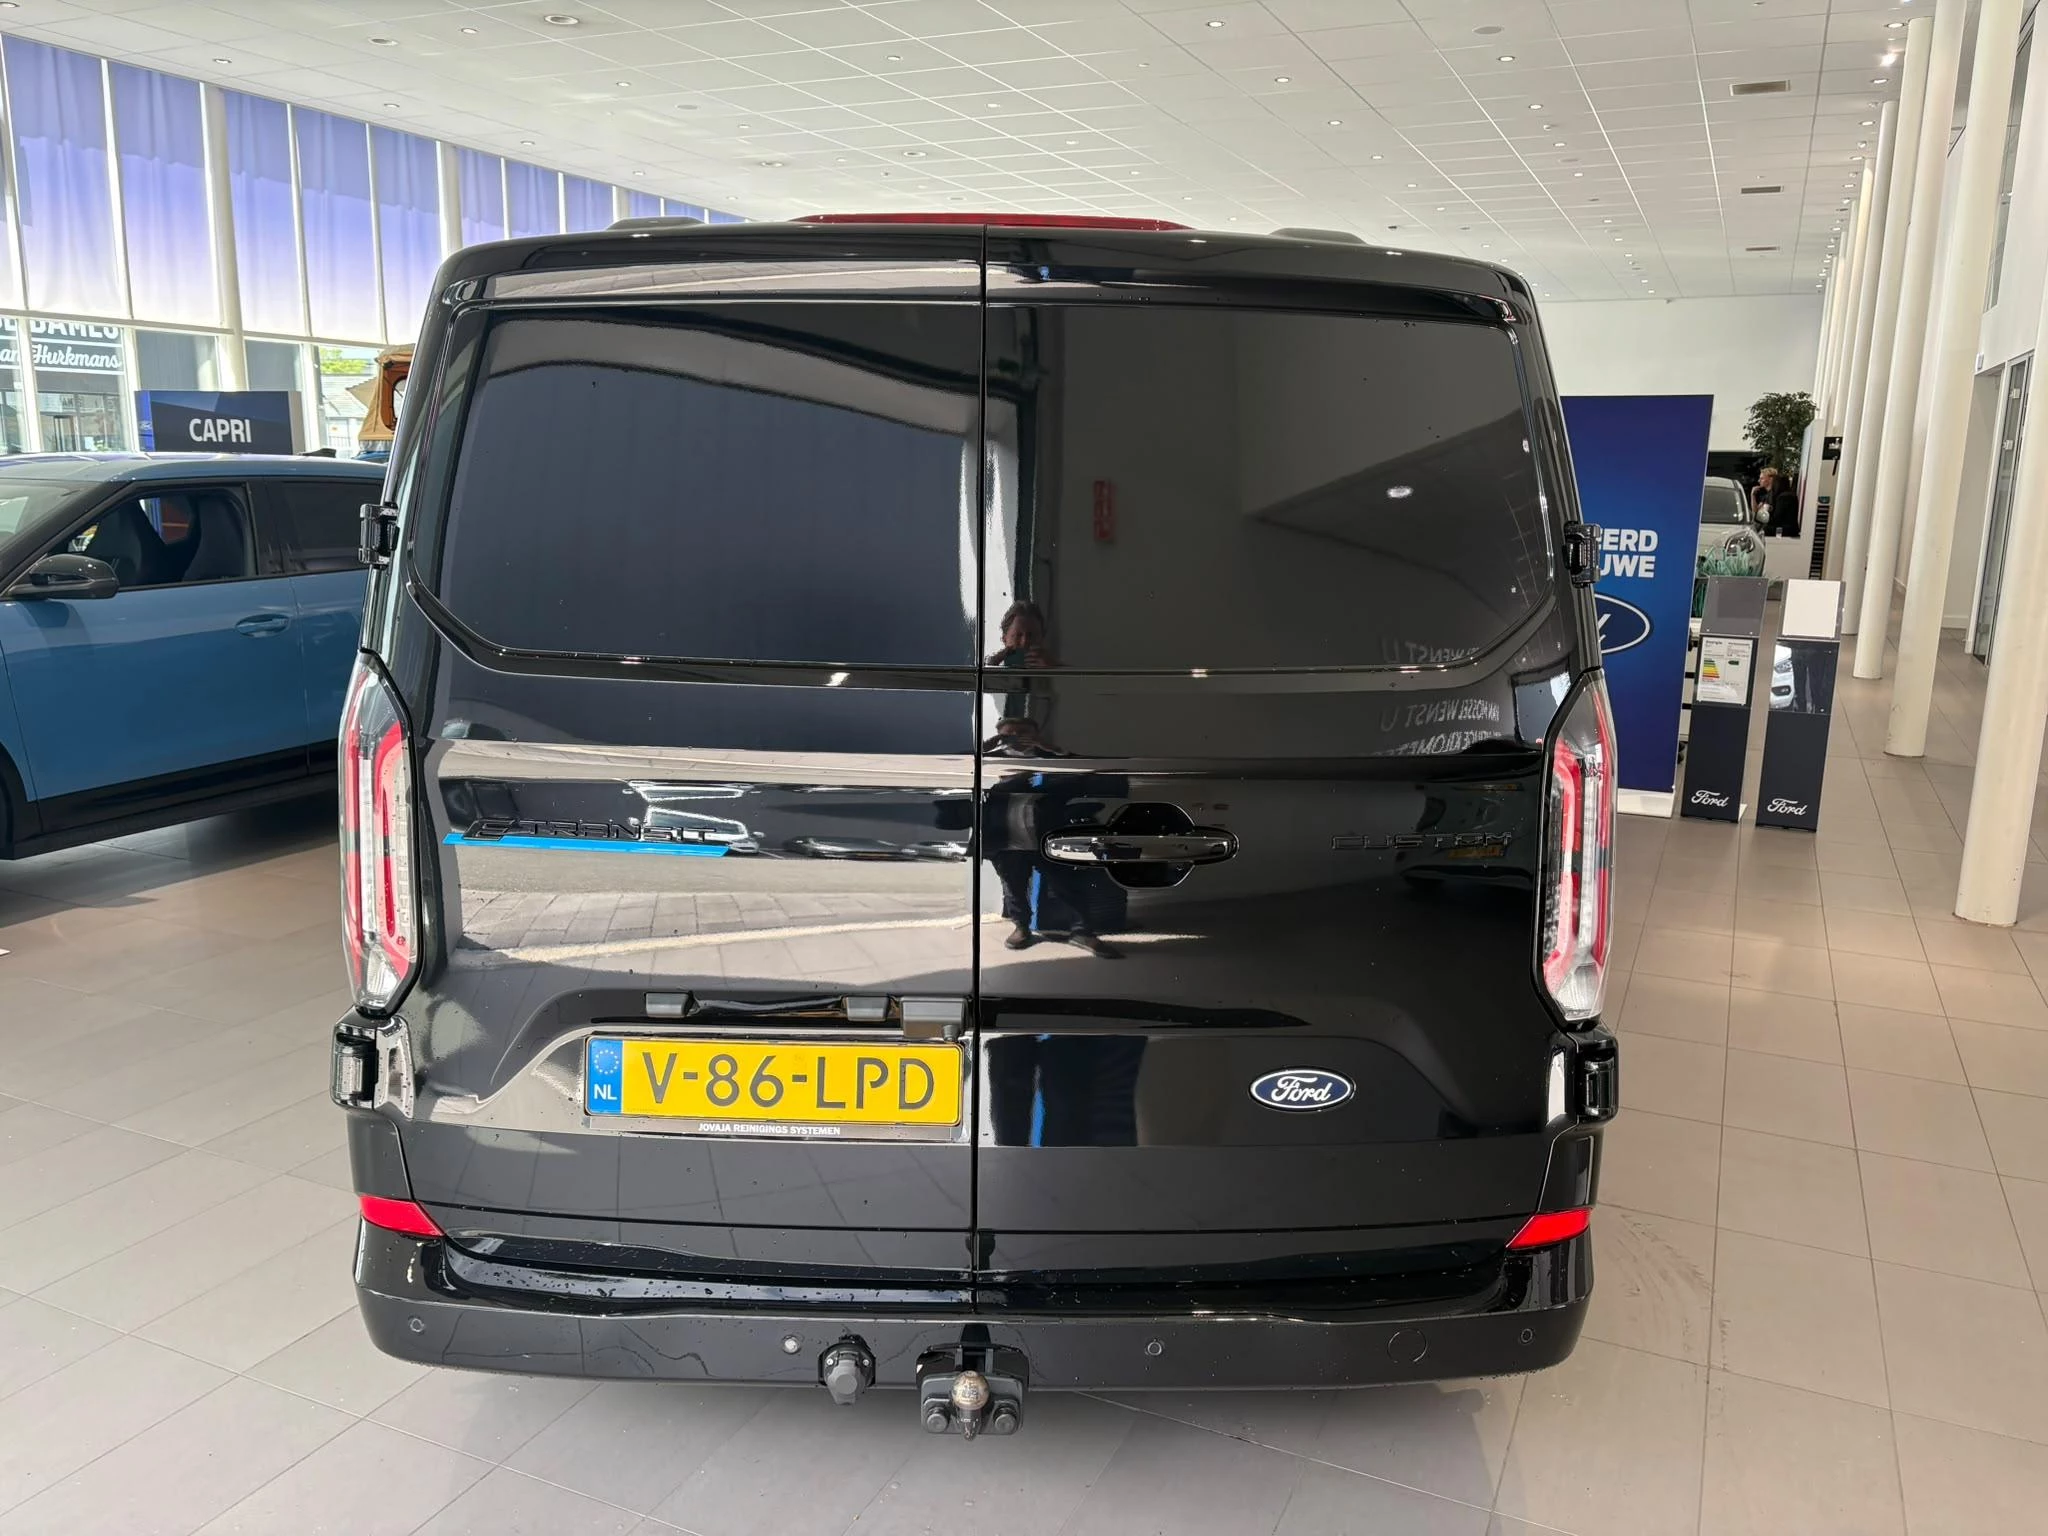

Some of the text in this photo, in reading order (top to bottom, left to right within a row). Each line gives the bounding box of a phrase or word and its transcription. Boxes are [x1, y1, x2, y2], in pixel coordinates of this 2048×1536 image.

[31, 343, 123, 368] Hurkmans
[189, 418, 252, 443] CAPRI
[1691, 790, 1729, 807] Ford
[1767, 798, 1808, 815] Ford
[642, 1051, 935, 1111] V-86-LPD
[1271, 1076, 1333, 1102] Ford
[594, 1084, 618, 1100] NL
[698, 1123, 841, 1135] JOVAJA REINIGINGS SYSTEMEN
